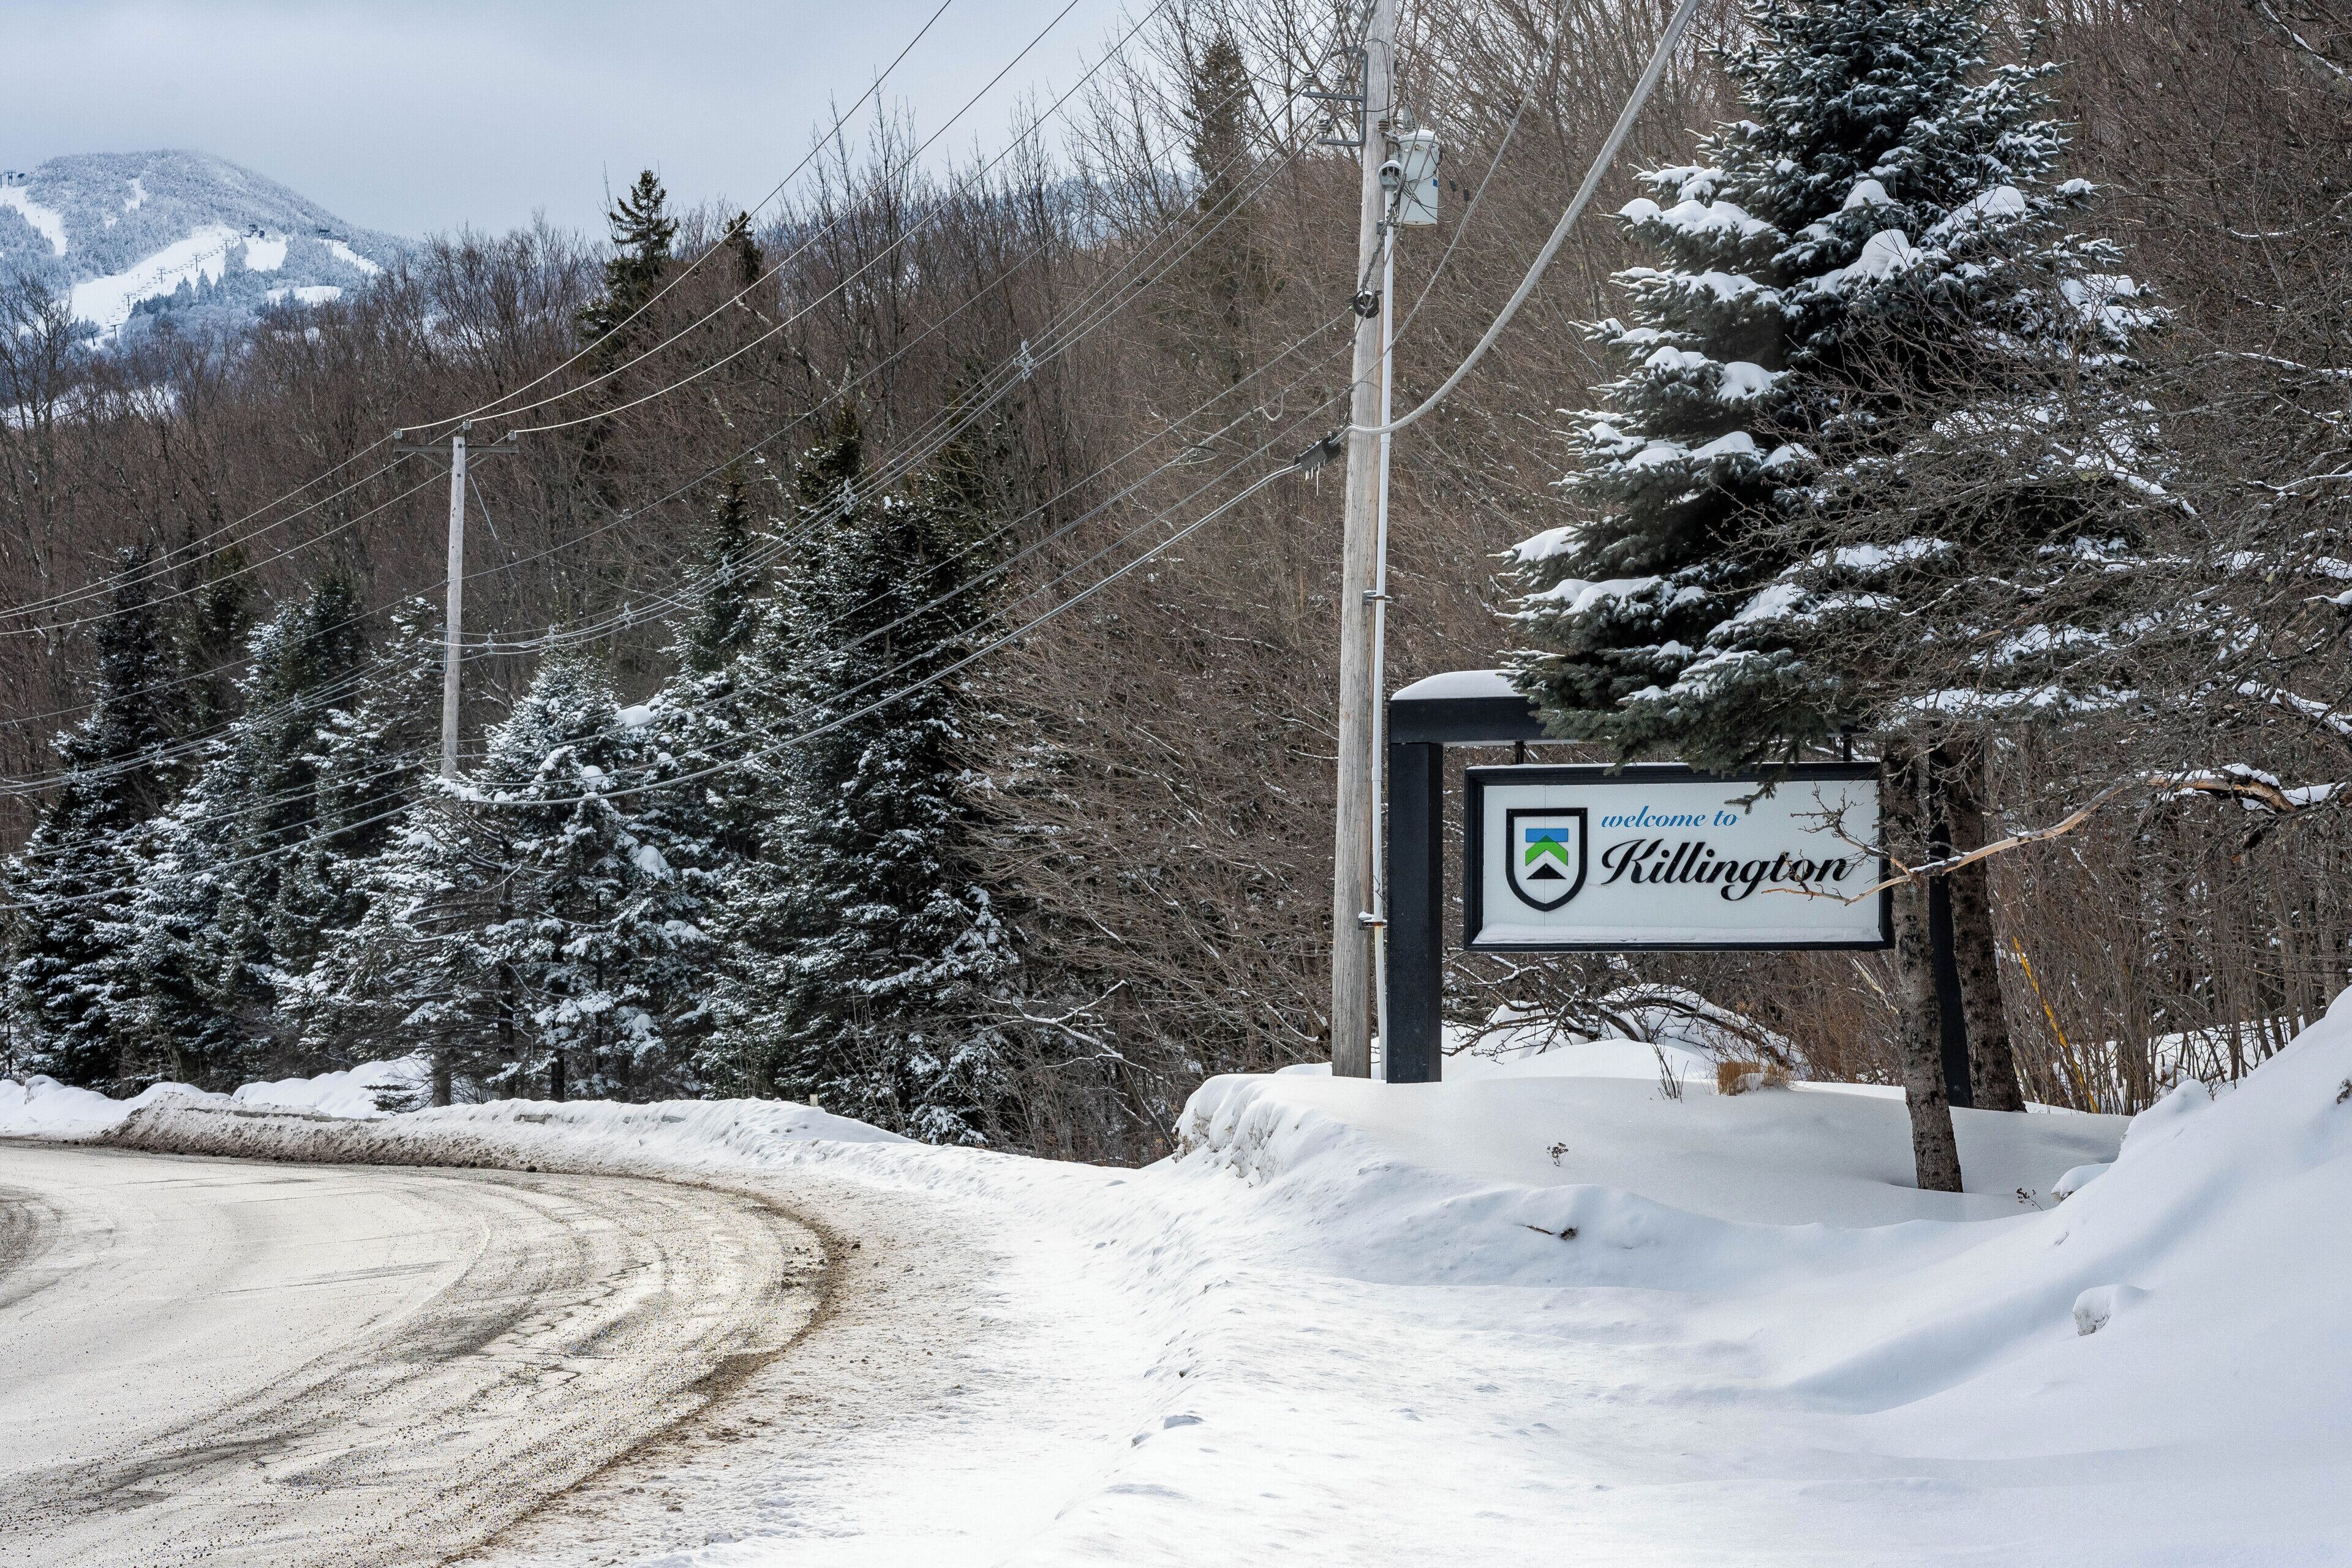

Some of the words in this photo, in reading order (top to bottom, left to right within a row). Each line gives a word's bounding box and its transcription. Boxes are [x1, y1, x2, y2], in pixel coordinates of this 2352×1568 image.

[1601, 805, 1709, 827] welcome
[1713, 810, 1742, 826] to
[1600, 839, 1855, 901] Killington
